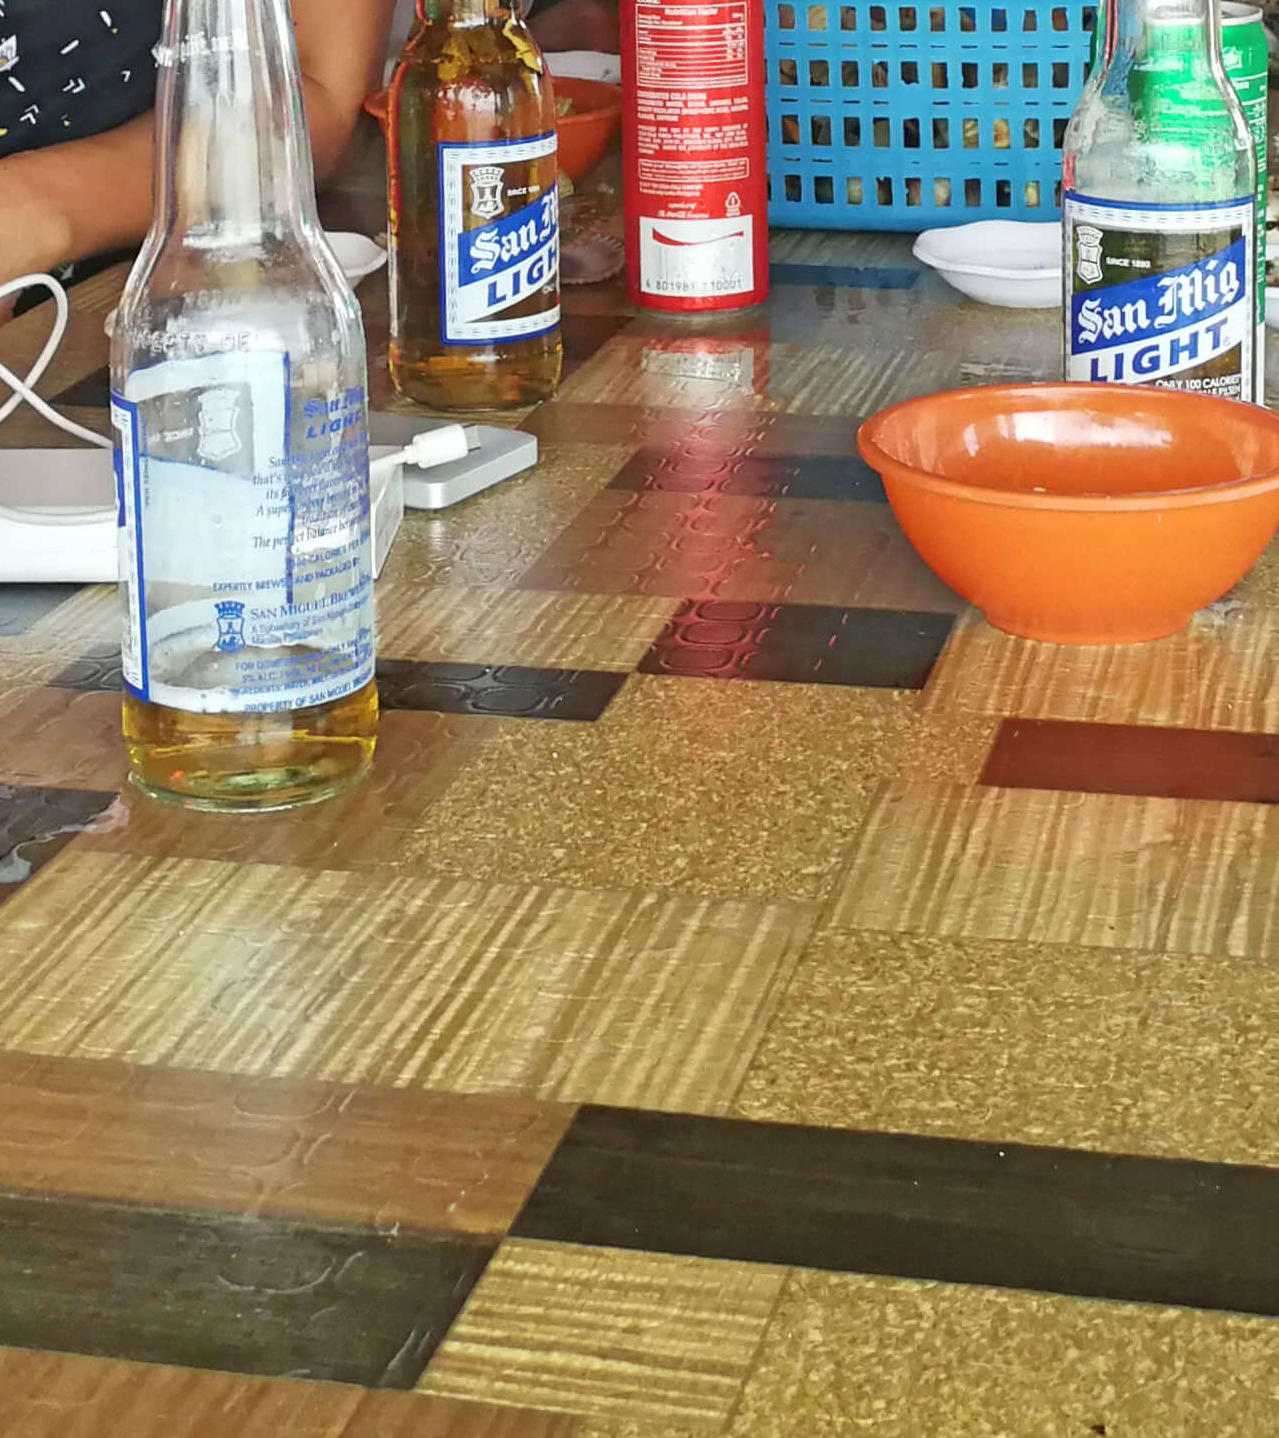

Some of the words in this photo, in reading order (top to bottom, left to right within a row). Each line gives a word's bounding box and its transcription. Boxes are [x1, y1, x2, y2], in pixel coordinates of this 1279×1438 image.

[470, 219, 539, 275] San
[1077, 297, 1152, 344] San
[1154, 260, 1240, 329] Mig
[1090, 316, 1229, 382] LIGHT
[1186, 378, 1202, 390] 100
[306, 411, 363, 440] LIGHT
[253, 472, 282, 486] that's
[253, 536, 271, 549] The
[250, 607, 277, 620] SAN
[279, 597, 328, 617] MIGUEL
[295, 695, 306, 707] OF
[309, 690, 326, 704] SAN
